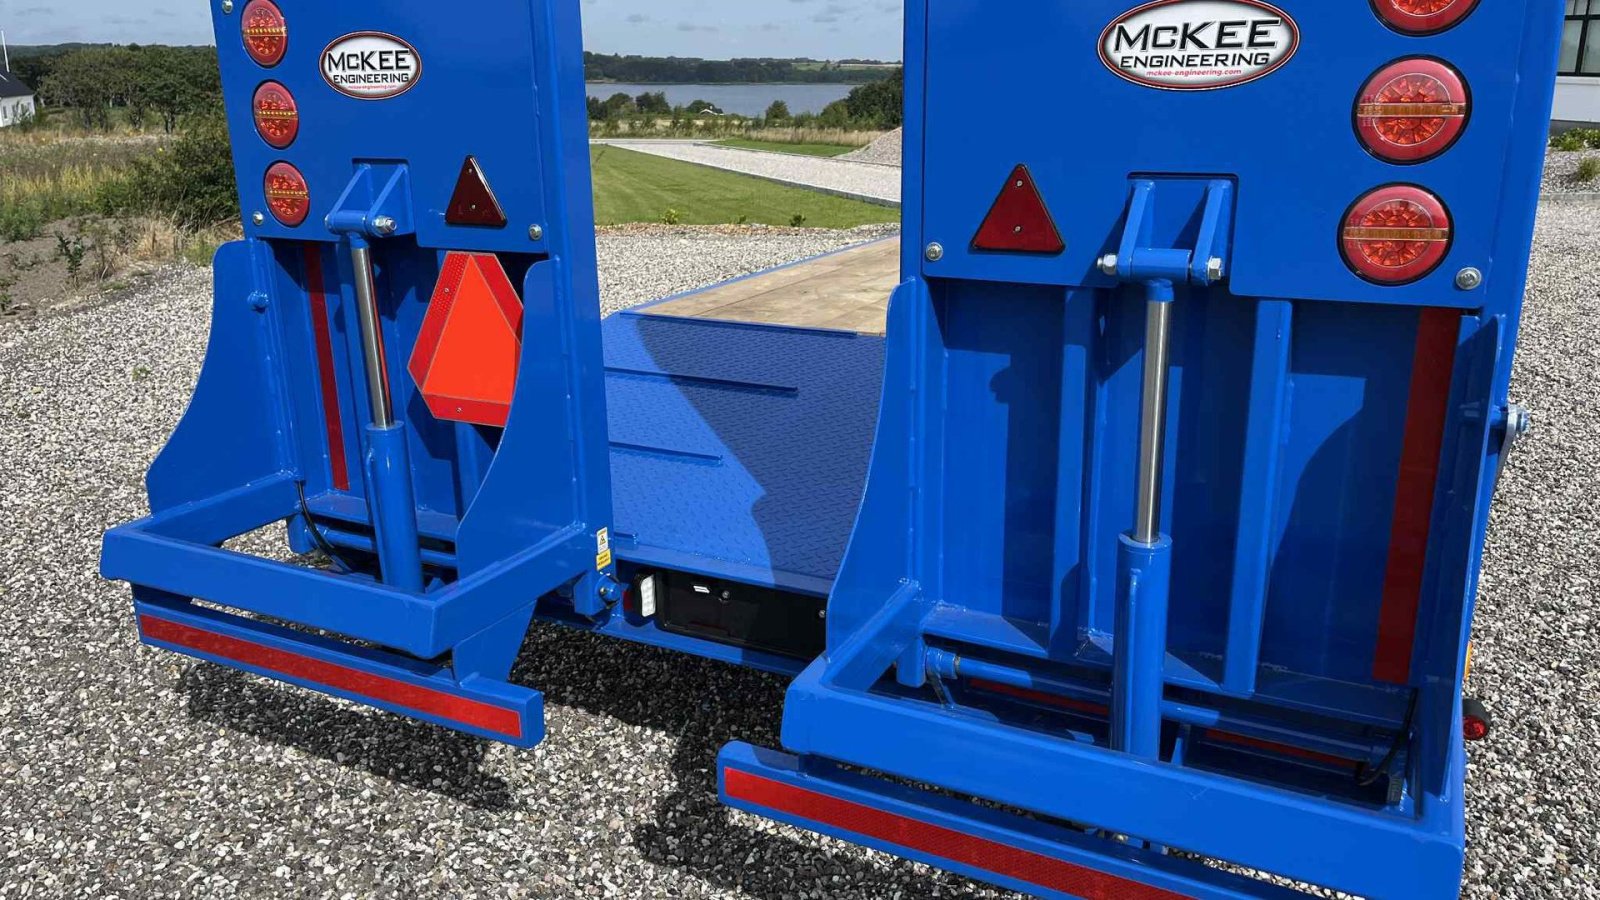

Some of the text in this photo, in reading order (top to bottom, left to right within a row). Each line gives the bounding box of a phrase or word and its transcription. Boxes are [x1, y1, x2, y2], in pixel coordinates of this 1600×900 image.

[1120, 53, 1270, 68] ENGINEERING
[333, 73, 409, 84] ENGINEERING
[1146, 69, 1242, 77] mckee-engineering.com
